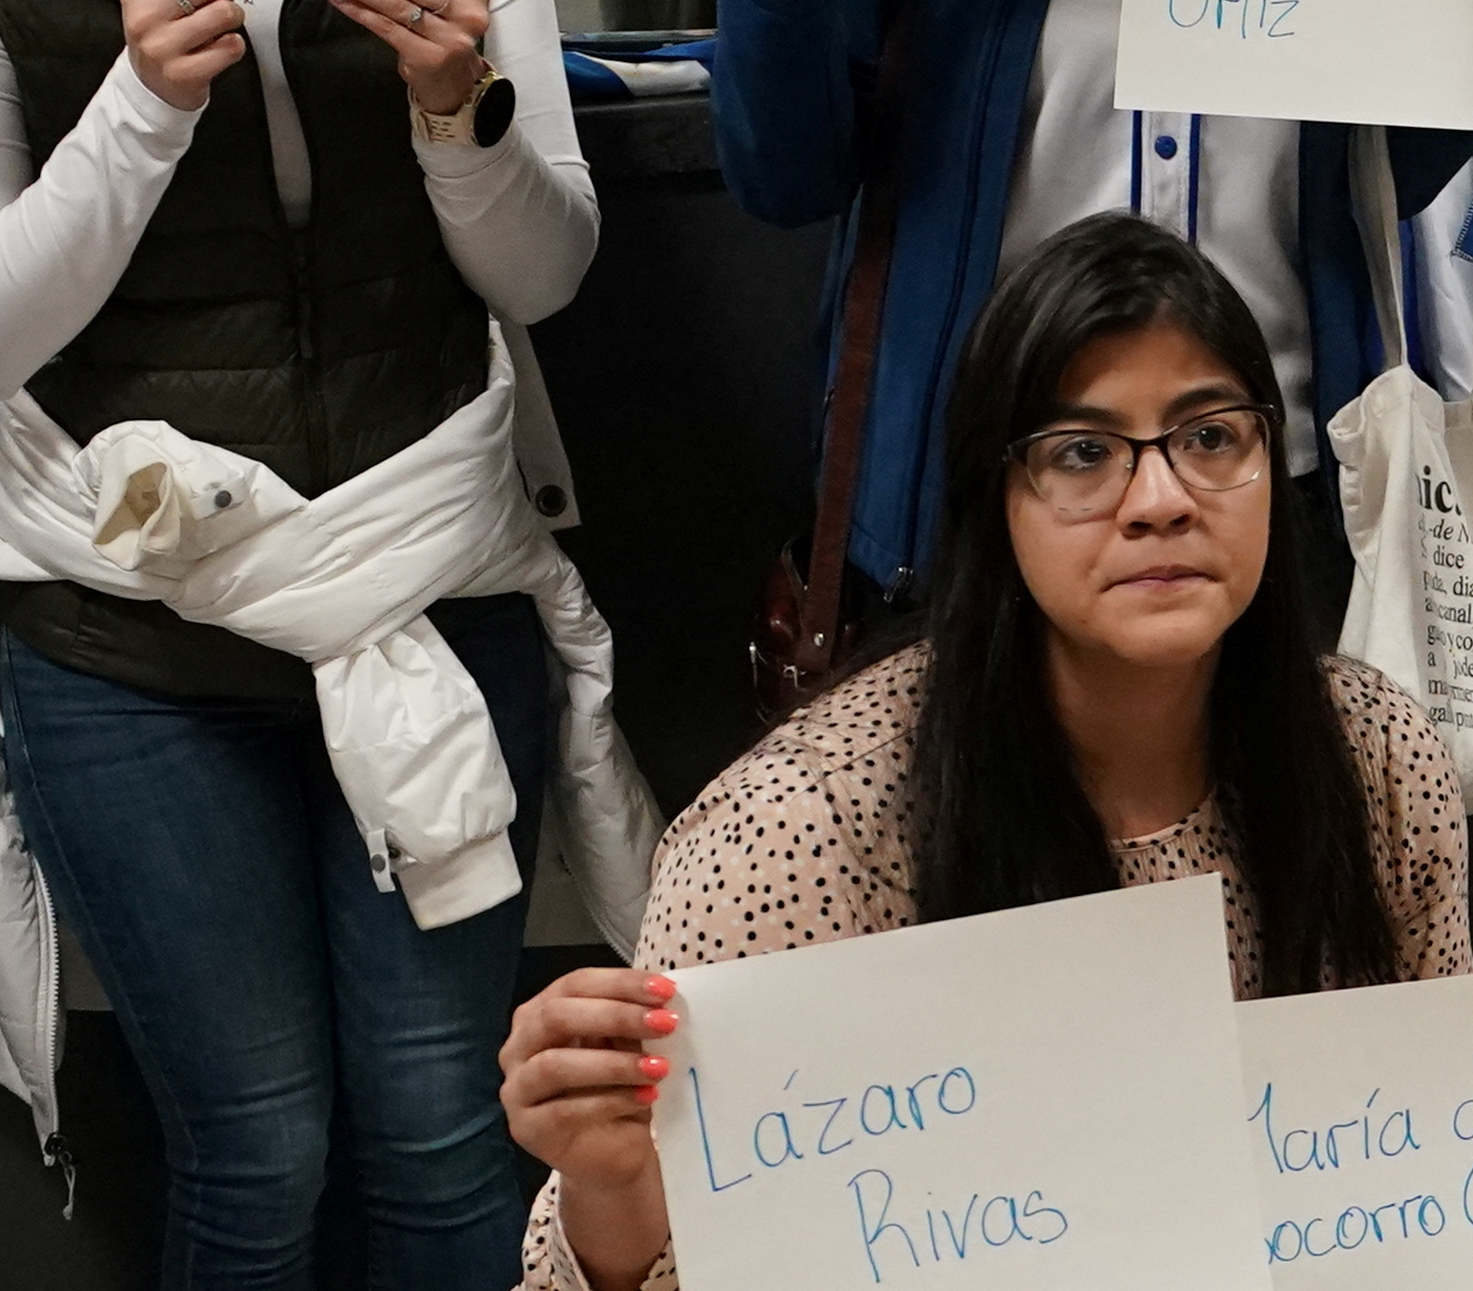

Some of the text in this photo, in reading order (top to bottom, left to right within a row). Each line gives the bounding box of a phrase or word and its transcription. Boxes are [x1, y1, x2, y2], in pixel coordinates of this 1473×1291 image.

[688, 1066, 976, 1193] Lázaro
[847, 1169, 1069, 1284] Rivas
[1263, 1195, 1446, 1264] ocorro
